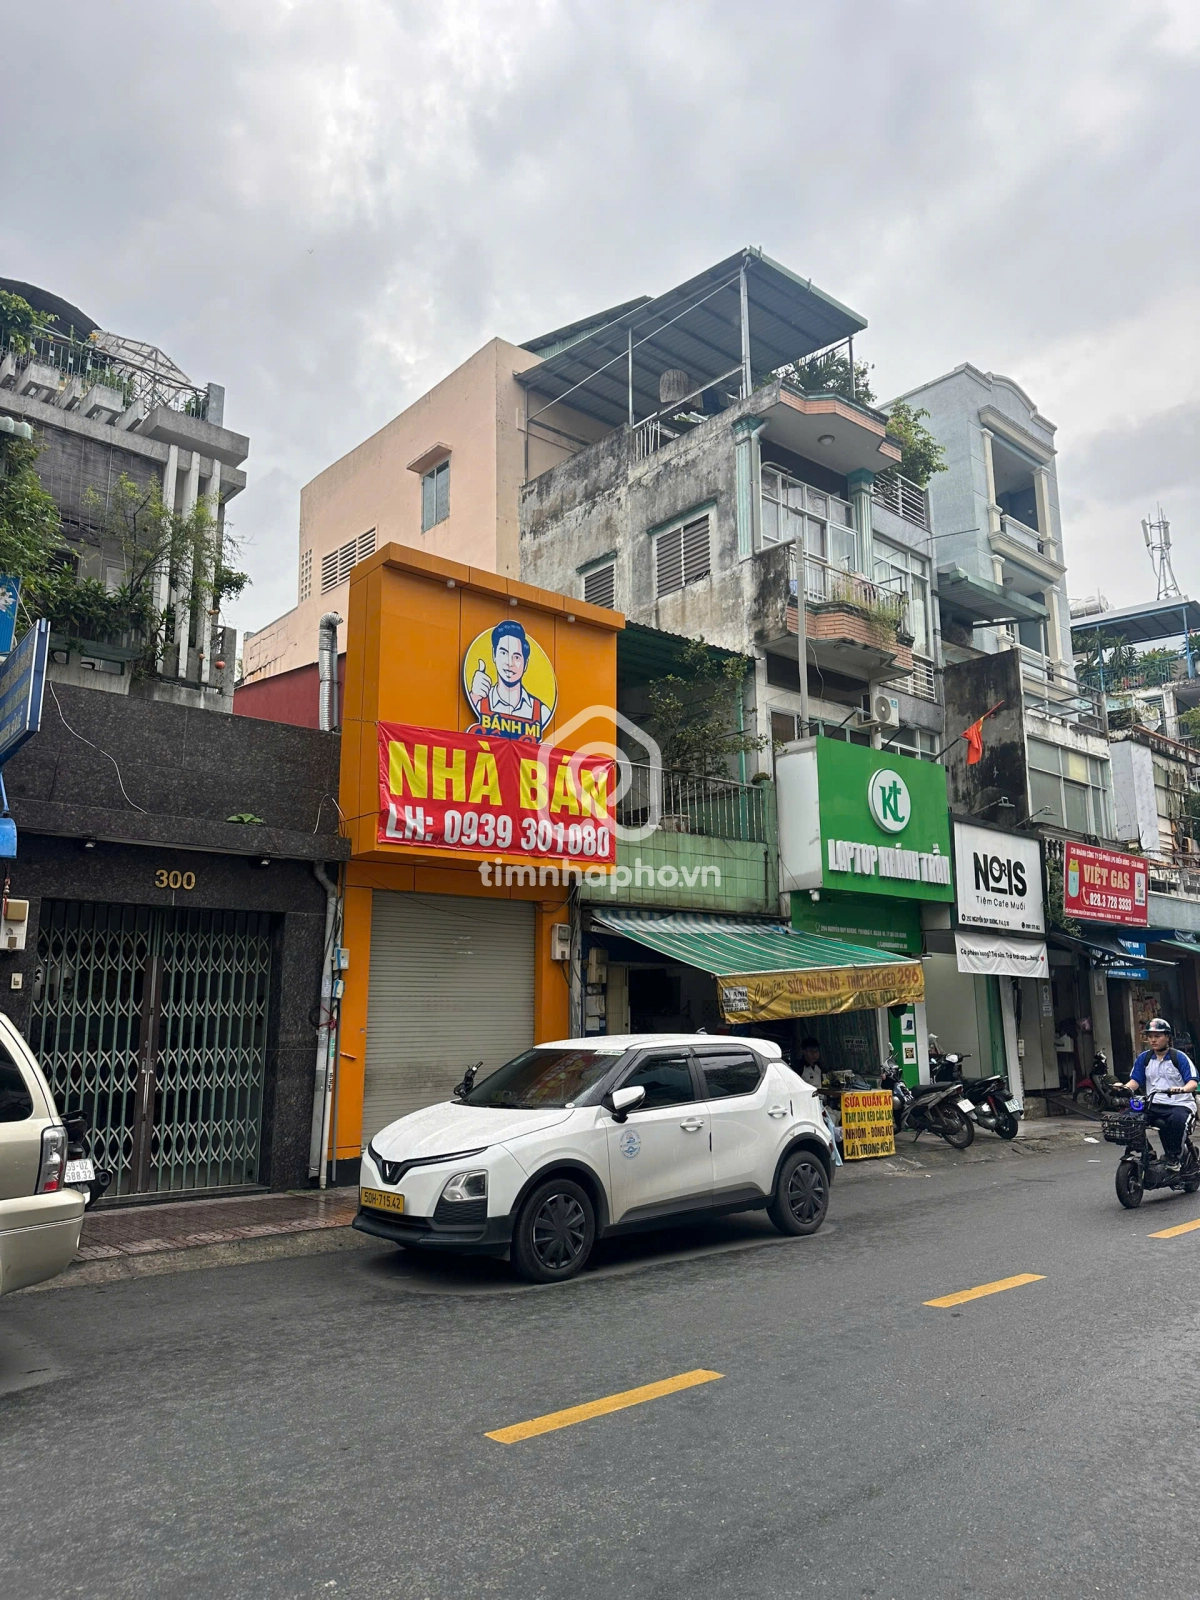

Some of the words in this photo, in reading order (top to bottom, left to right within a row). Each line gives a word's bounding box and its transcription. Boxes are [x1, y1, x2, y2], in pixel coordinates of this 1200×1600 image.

[482, 713, 522, 735] BÁNH
[525, 722, 541, 738] MÌ
[388, 741, 503, 806] NHÀ
[519, 755, 609, 819] BÁN
[385, 803, 434, 843] LH:
[443, 811, 513, 847] 0939
[520, 818, 610, 858] 301080
[827, 838, 878, 876] LAPTOP
[155, 869, 195, 890] 300
[1083, 863, 1108, 889] VIỆT
[1111, 869, 1130, 890] GAS
[976, 895, 992, 906] Tiệm
[993, 898, 1009, 908] Cafe
[897, 967, 919, 984] 296
[364, 1191, 400, 1209] 50H-715.42
